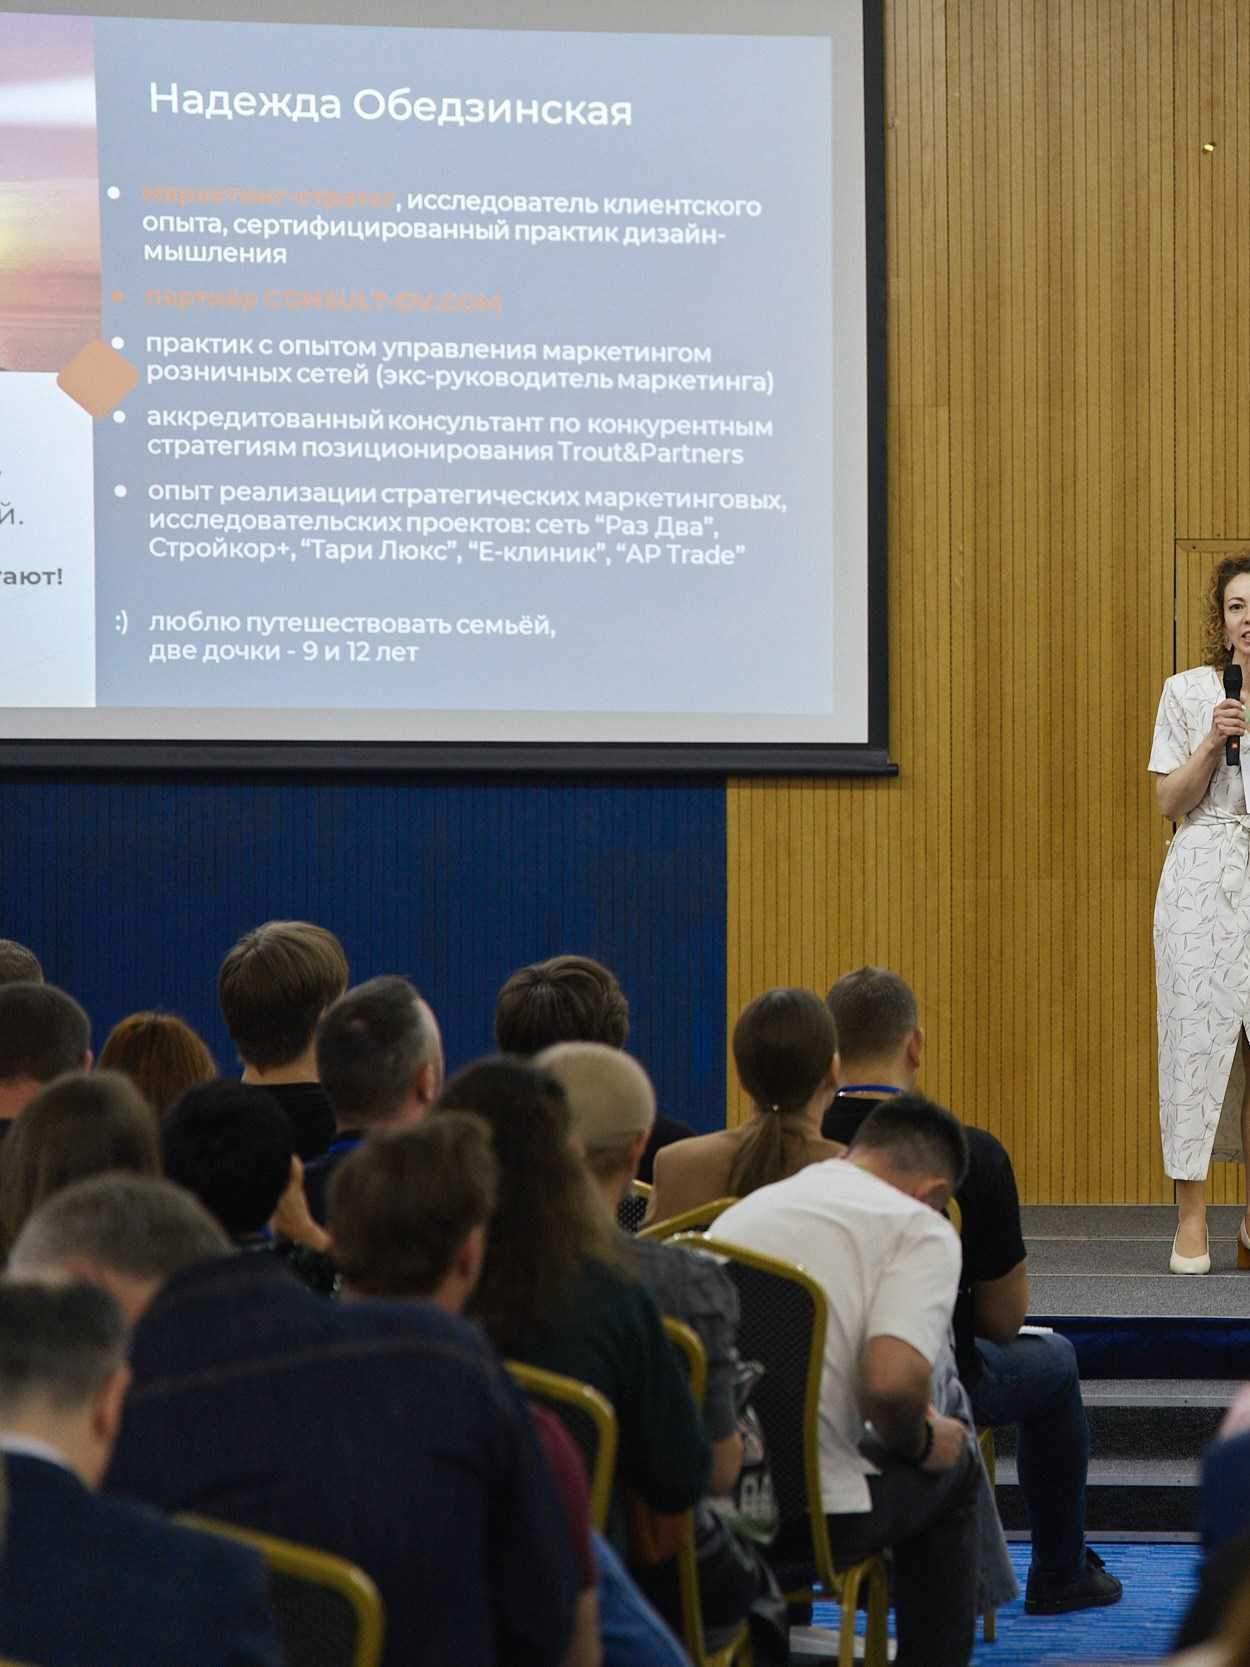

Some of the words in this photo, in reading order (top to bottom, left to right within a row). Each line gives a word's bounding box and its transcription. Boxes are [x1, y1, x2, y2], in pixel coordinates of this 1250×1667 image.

[150, 81, 341, 123] Надежда
[353, 87, 632, 127] Обедзинская
[142, 186, 402, 213] маркетинг-стратег,
[407, 193, 599, 213] исследователь
[603, 197, 762, 216] клиентского
[142, 215, 228, 237] опыта,
[233, 214, 510, 242] сертифицированный
[514, 224, 620, 246] практик
[622, 222, 726, 247] дизайн-
[144, 244, 287, 264] мышления
[144, 288, 258, 312] партнёр
[263, 290, 501, 314] CONSULT-DV.COM
[146, 336, 254, 357] практик
[258, 338, 273, 355] с
[278, 339, 377, 357] опытом
[381, 341, 537, 362] управления
[542, 344, 712, 365] маркетингом
[147, 364, 293, 385] розничных
[296, 362, 369, 385] сетей
[376, 363, 614, 391] (экс-руководитель
[617, 370, 774, 396] маркетинга)
[147, 408, 384, 431] аккредитованный
[388, 414, 544, 436] консультант
[549, 416, 581, 433] по
[588, 417, 773, 439] конкурентным
[147, 438, 297, 459] стратегиям
[302, 441, 554, 464] позиционирования
[557, 440, 744, 464] Trout&Partners
[148, 484, 214, 501] опыт
[219, 485, 377, 506] реализации
[381, 487, 580, 508] стратегических
[585, 490, 787, 513] маркетинговых,
[149, 512, 403, 533] исследовательских
[406, 516, 531, 537] проектов:
[535, 518, 590, 535] сеть
[148, 536, 297, 563] Стройкор+,
[148, 610, 241, 632] люблю
[246, 615, 452, 637] путешествовать
[456, 614, 556, 638] семьёй,
[148, 643, 198, 663] две
[202, 644, 280, 664] дочки
[302, 640, 319, 661] 9
[324, 645, 340, 661] и
[346, 640, 371, 662] 12
[375, 645, 419, 662] лет
